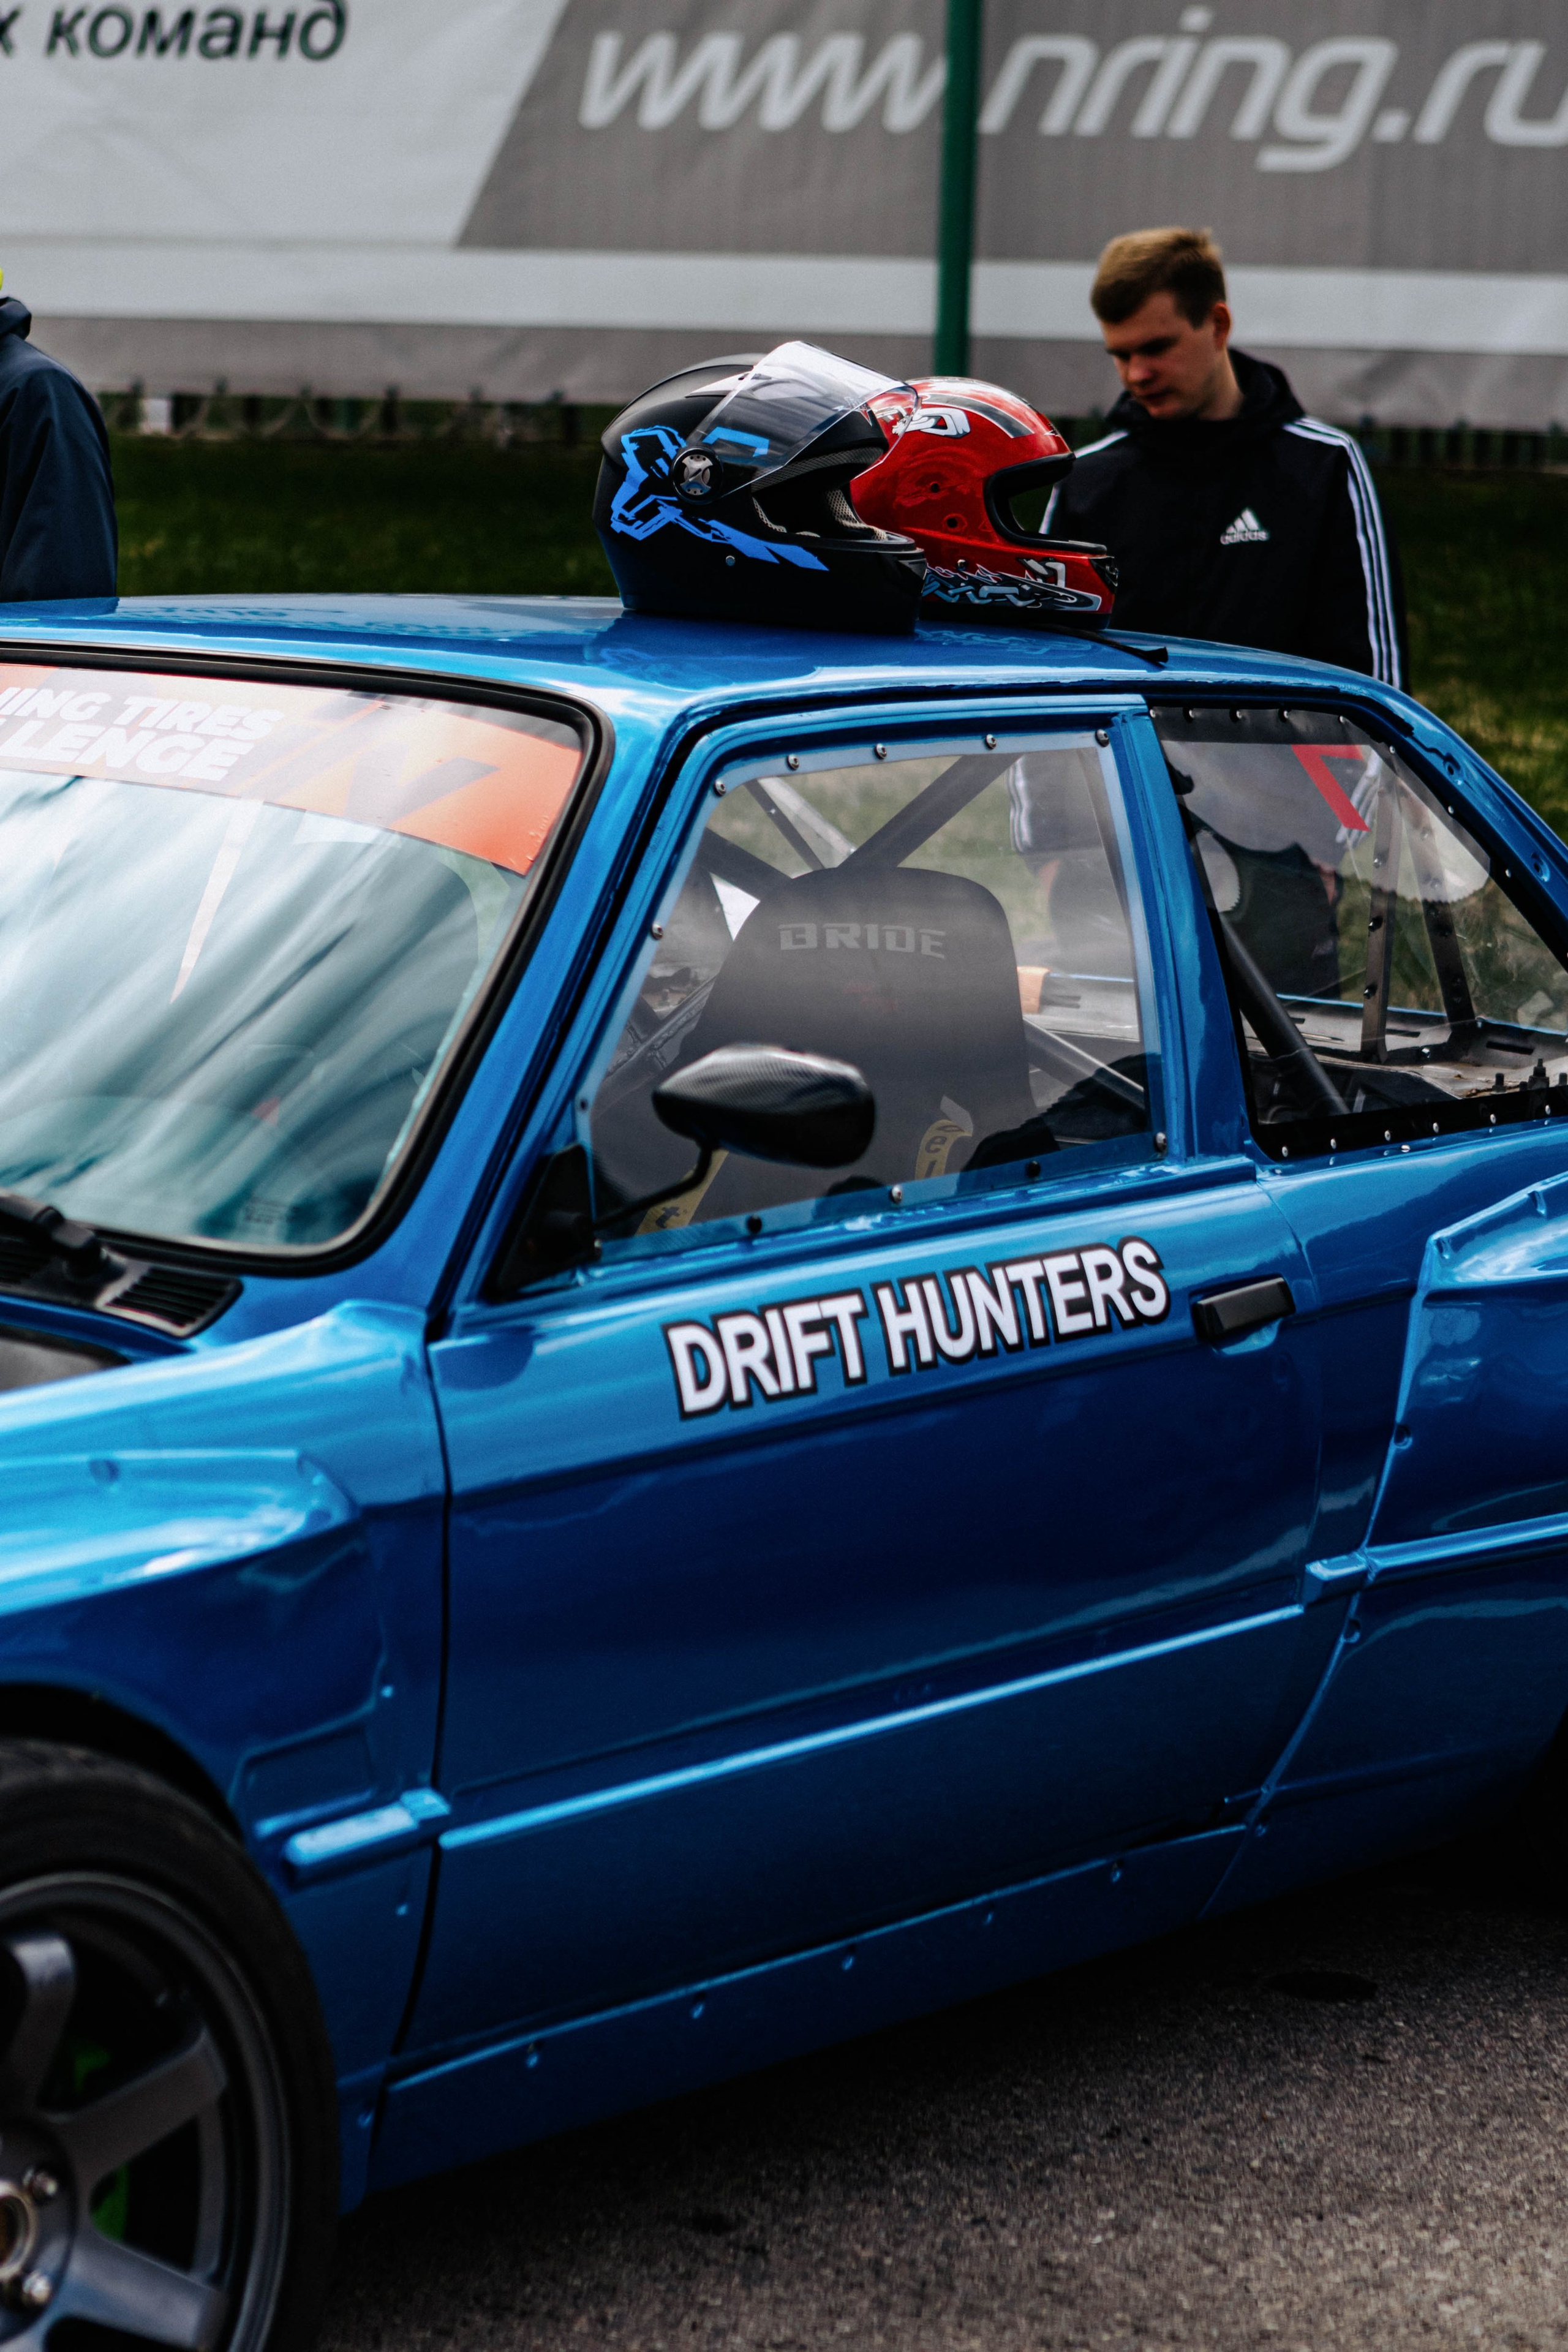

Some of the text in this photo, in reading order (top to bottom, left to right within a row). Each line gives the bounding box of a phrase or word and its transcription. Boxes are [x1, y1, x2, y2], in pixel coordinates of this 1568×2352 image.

[45, 0, 347, 61] команд
[1220, 529, 1269, 545] adidas
[113, 695, 286, 741] TIRES
[0, 718, 254, 782] LENGE
[777, 922, 947, 960] BRIDE
[665, 1240, 1170, 1415] DRIFT HUNTERS
